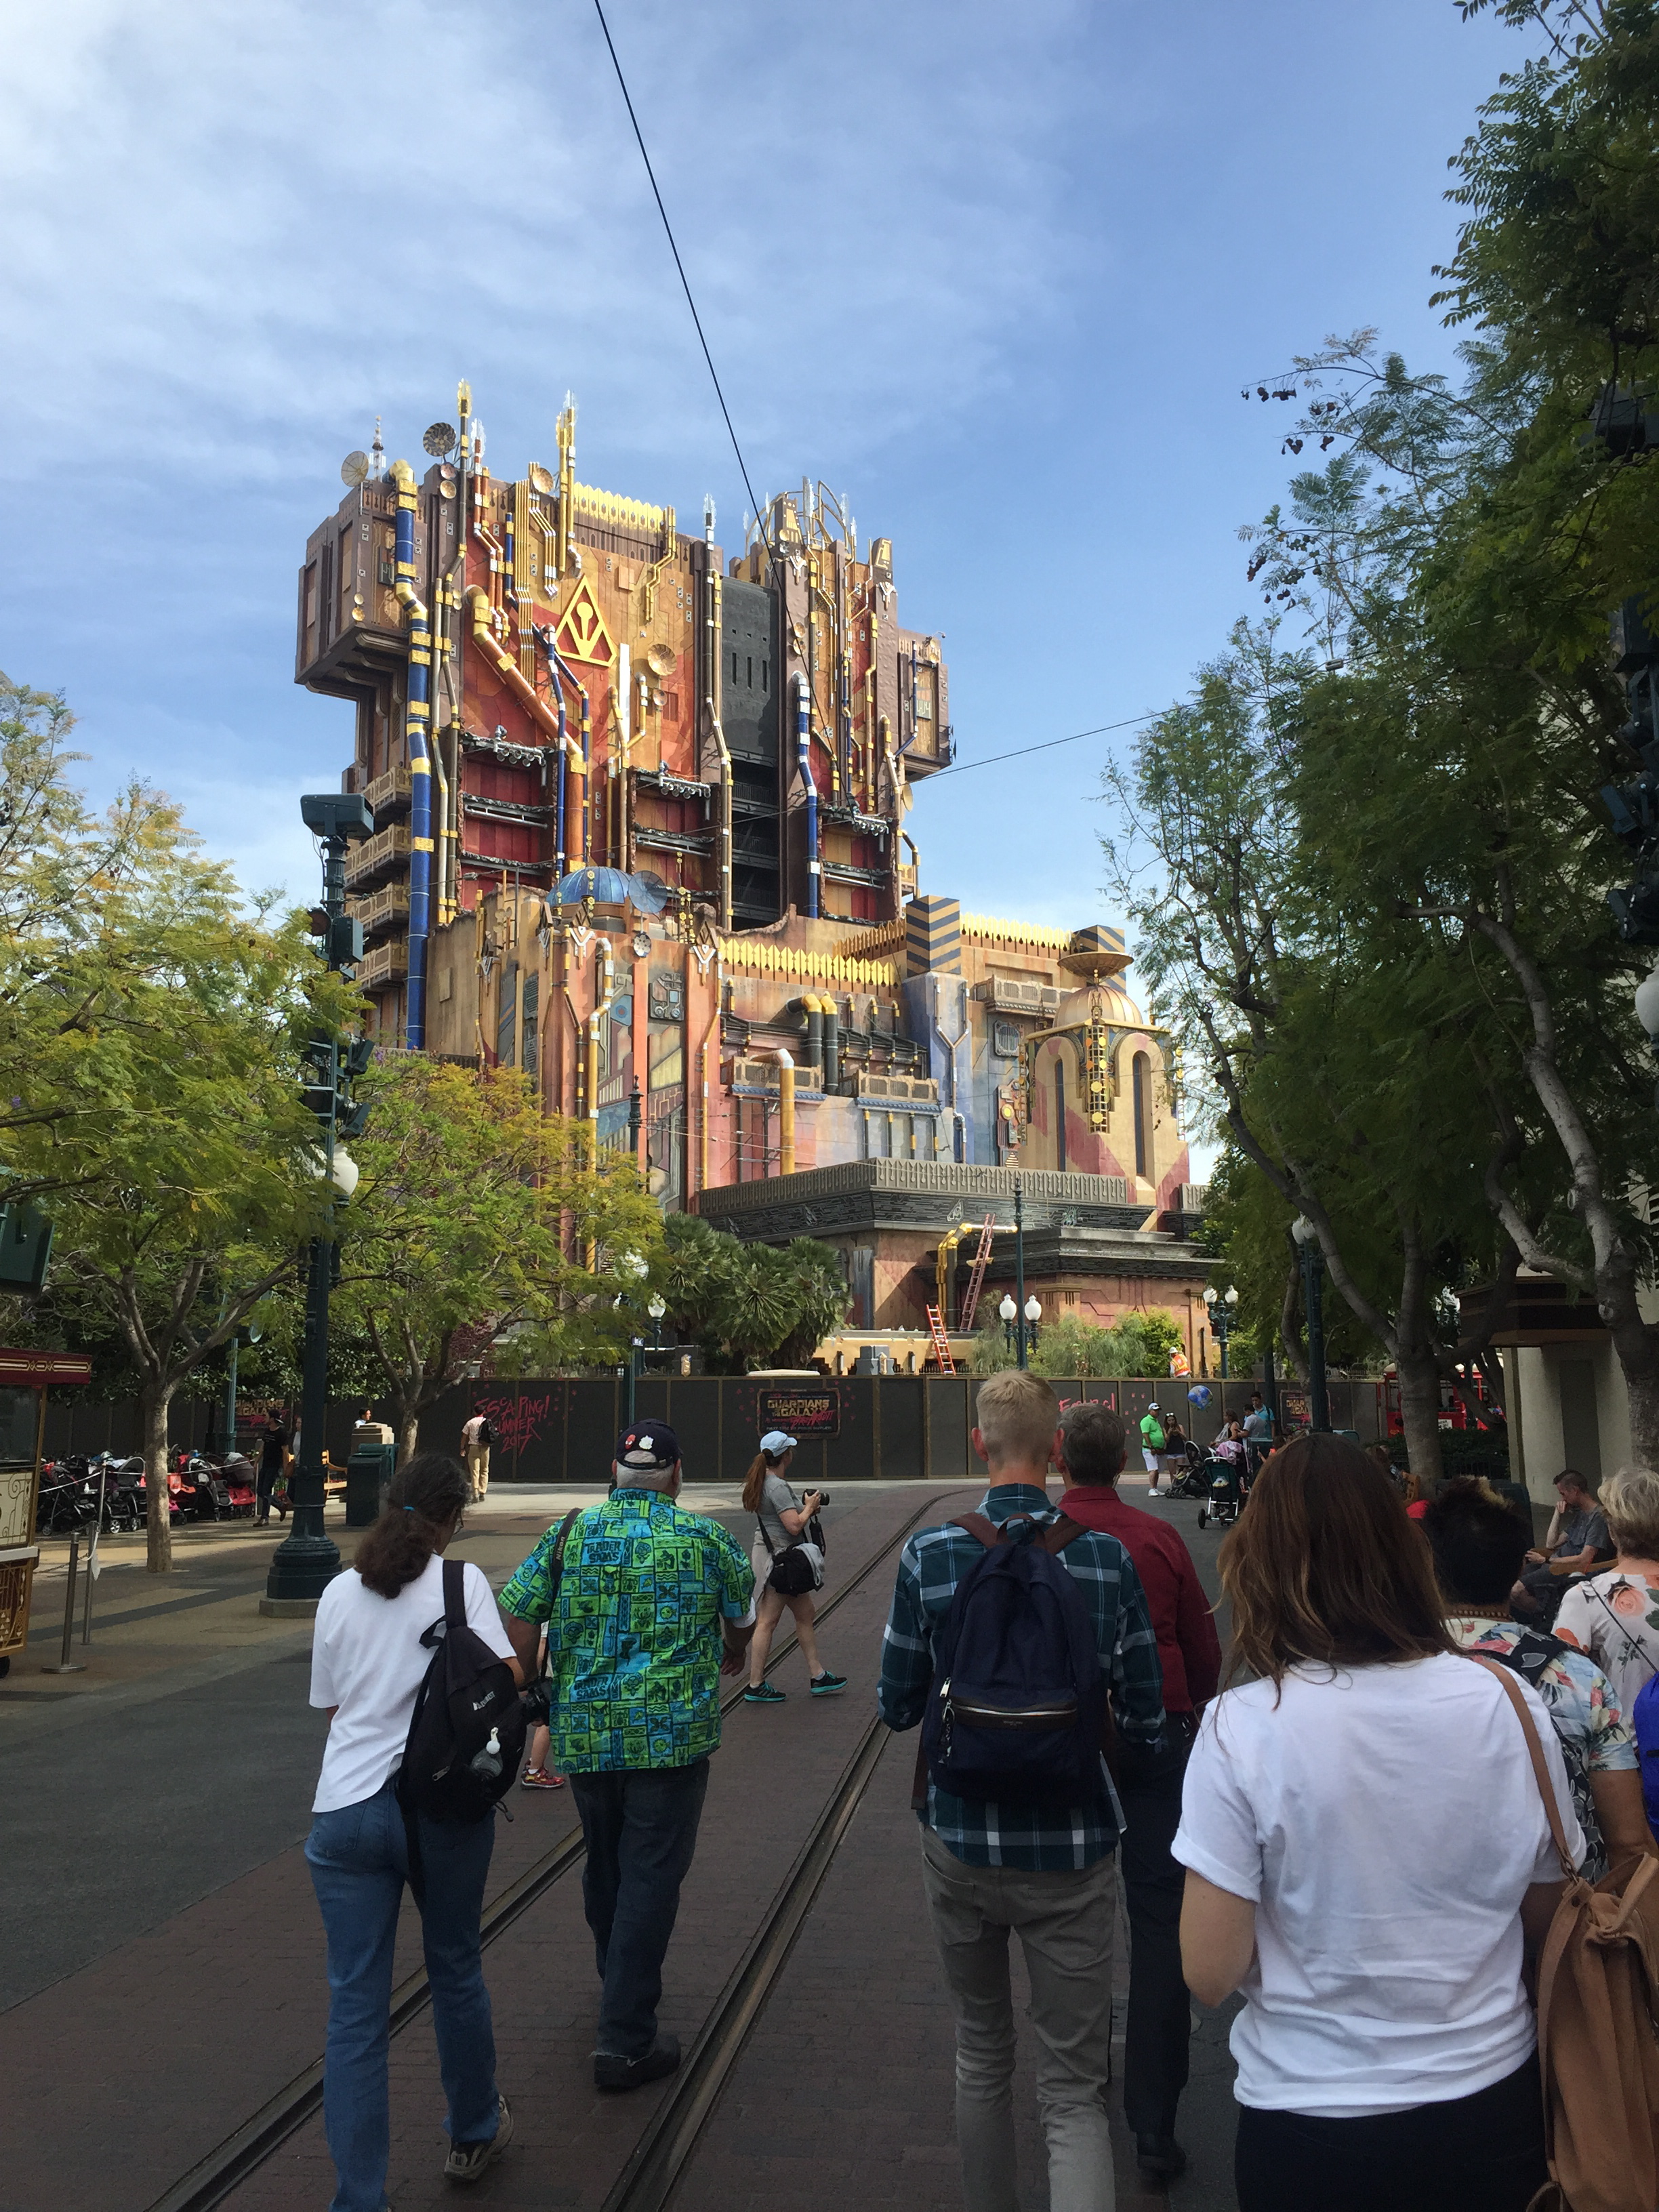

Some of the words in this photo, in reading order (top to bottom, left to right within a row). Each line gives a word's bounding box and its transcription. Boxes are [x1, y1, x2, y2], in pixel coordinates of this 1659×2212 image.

[767, 1399, 830, 1408] GUARDIANS
[500, 1433, 533, 1456] 2017
[556, 1536, 565, 1561] Nikon
